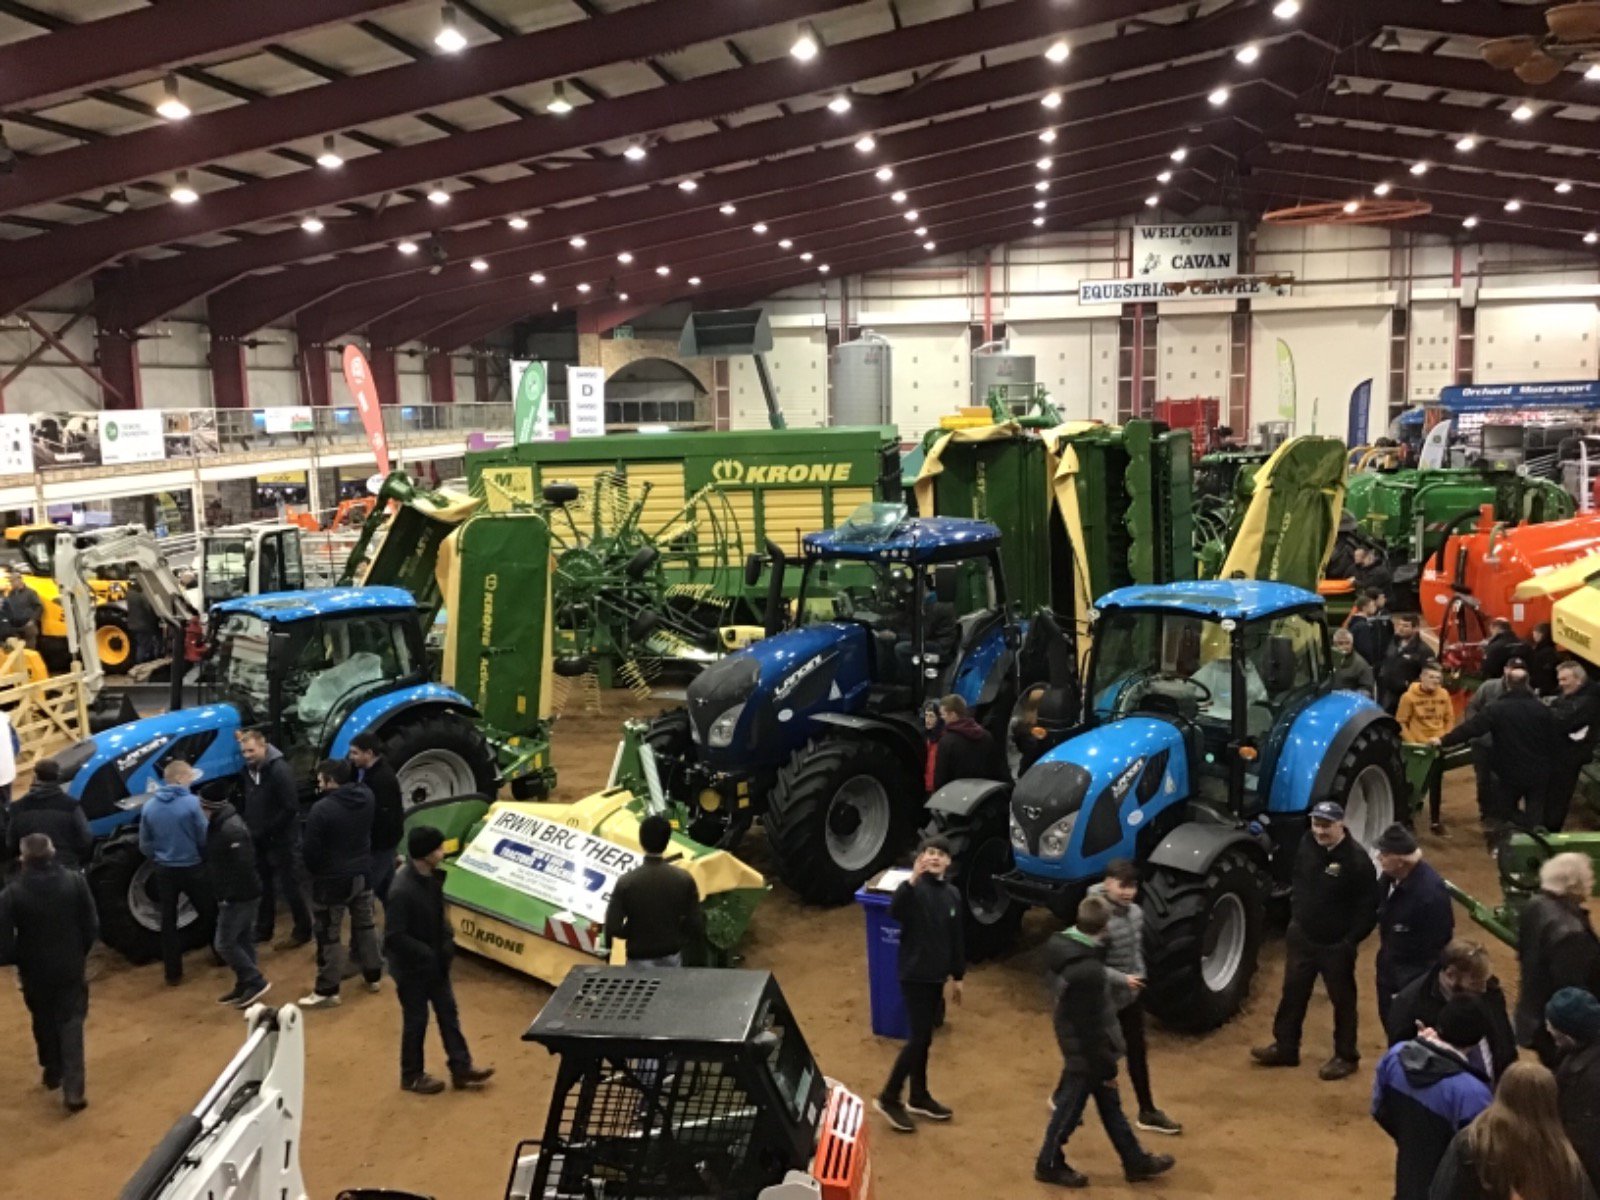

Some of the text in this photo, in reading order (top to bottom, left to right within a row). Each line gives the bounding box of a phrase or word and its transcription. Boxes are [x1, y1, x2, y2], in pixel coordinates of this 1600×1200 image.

[1141, 224, 1232, 239] WELCOME
[1171, 253, 1231, 269] CAVAN
[582, 384, 593, 396] D
[1462, 384, 1592, 397] Orchard Motorsport
[745, 462, 852, 483] KRONE
[481, 592, 494, 647] KRONE
[495, 811, 541, 837] IRWIN
[475, 928, 524, 955] KRONE
